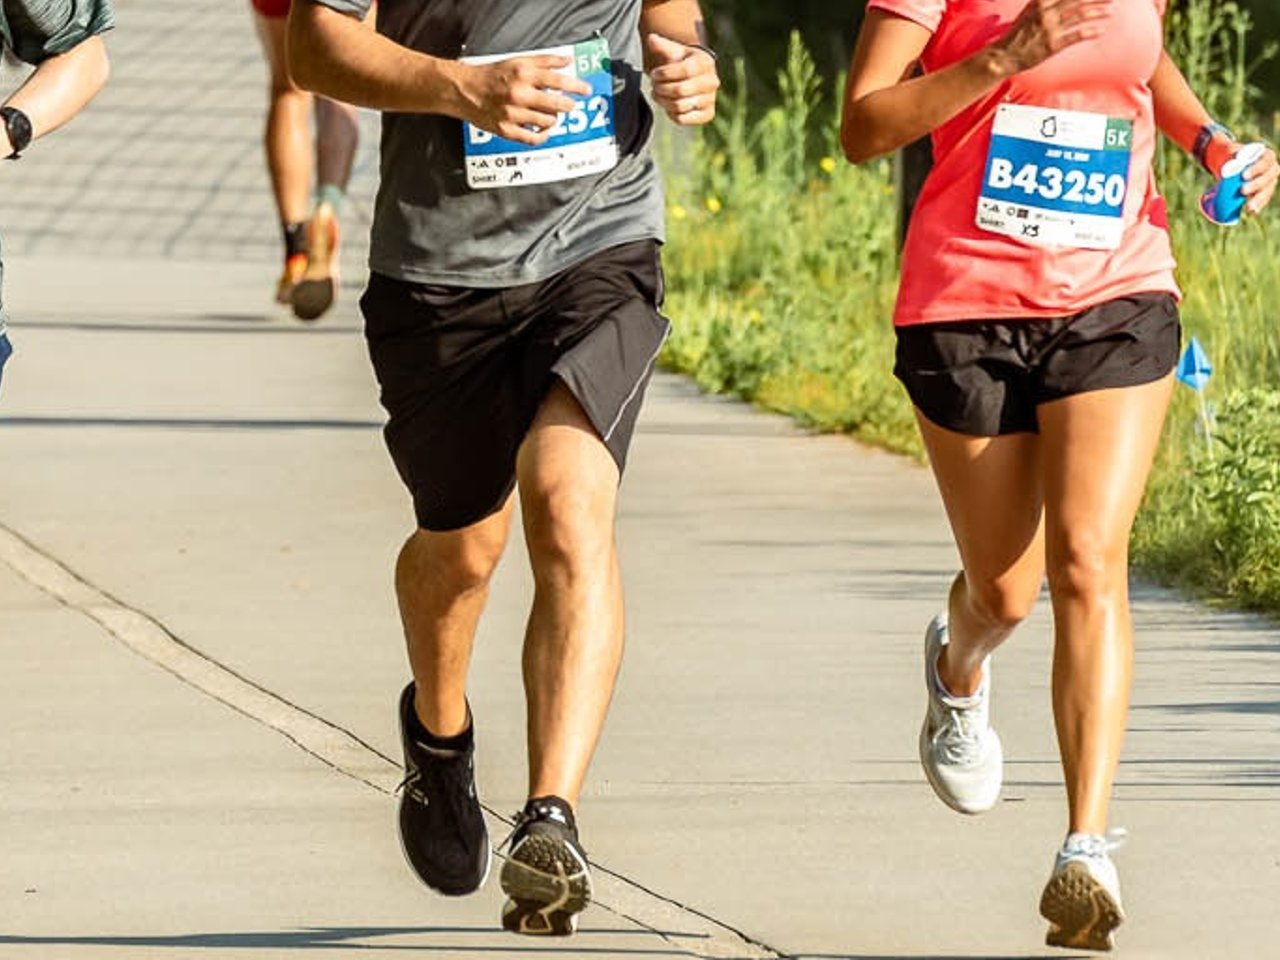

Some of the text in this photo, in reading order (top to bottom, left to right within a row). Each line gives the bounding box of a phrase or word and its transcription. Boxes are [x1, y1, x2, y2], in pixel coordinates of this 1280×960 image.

[578, 52, 602, 72] 5K
[468, 95, 611, 145] B252
[1106, 129, 1129, 146] 5K
[988, 157, 1126, 207] B43250
